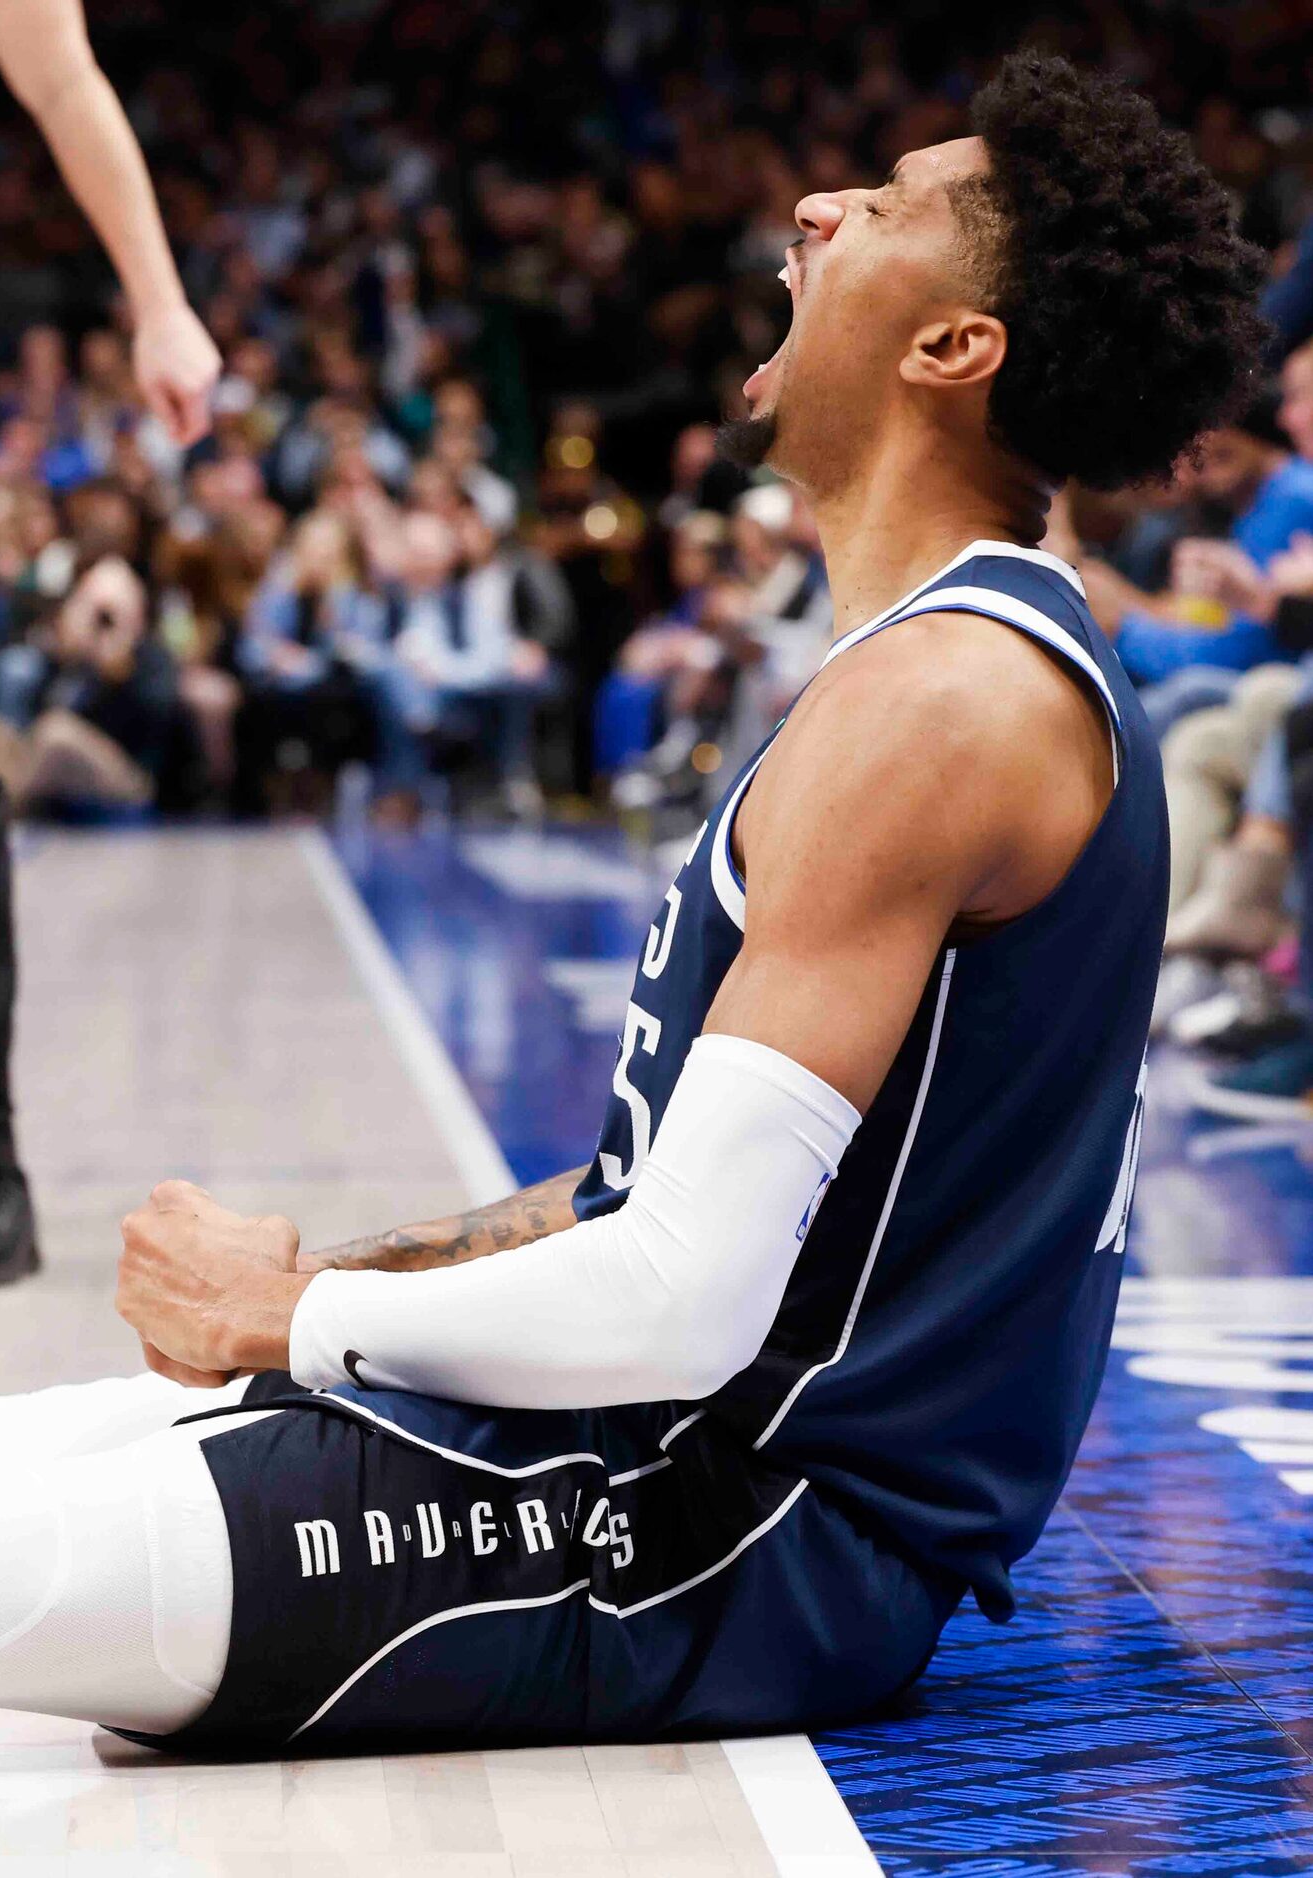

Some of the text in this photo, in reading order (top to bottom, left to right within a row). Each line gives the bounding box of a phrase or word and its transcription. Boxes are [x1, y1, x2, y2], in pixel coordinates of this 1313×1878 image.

[924, 1713, 1257, 1758] BRANDON
[912, 1749, 1311, 1806] JIM SPANARKEL
[864, 1785, 1306, 1851] GARY TRENT
